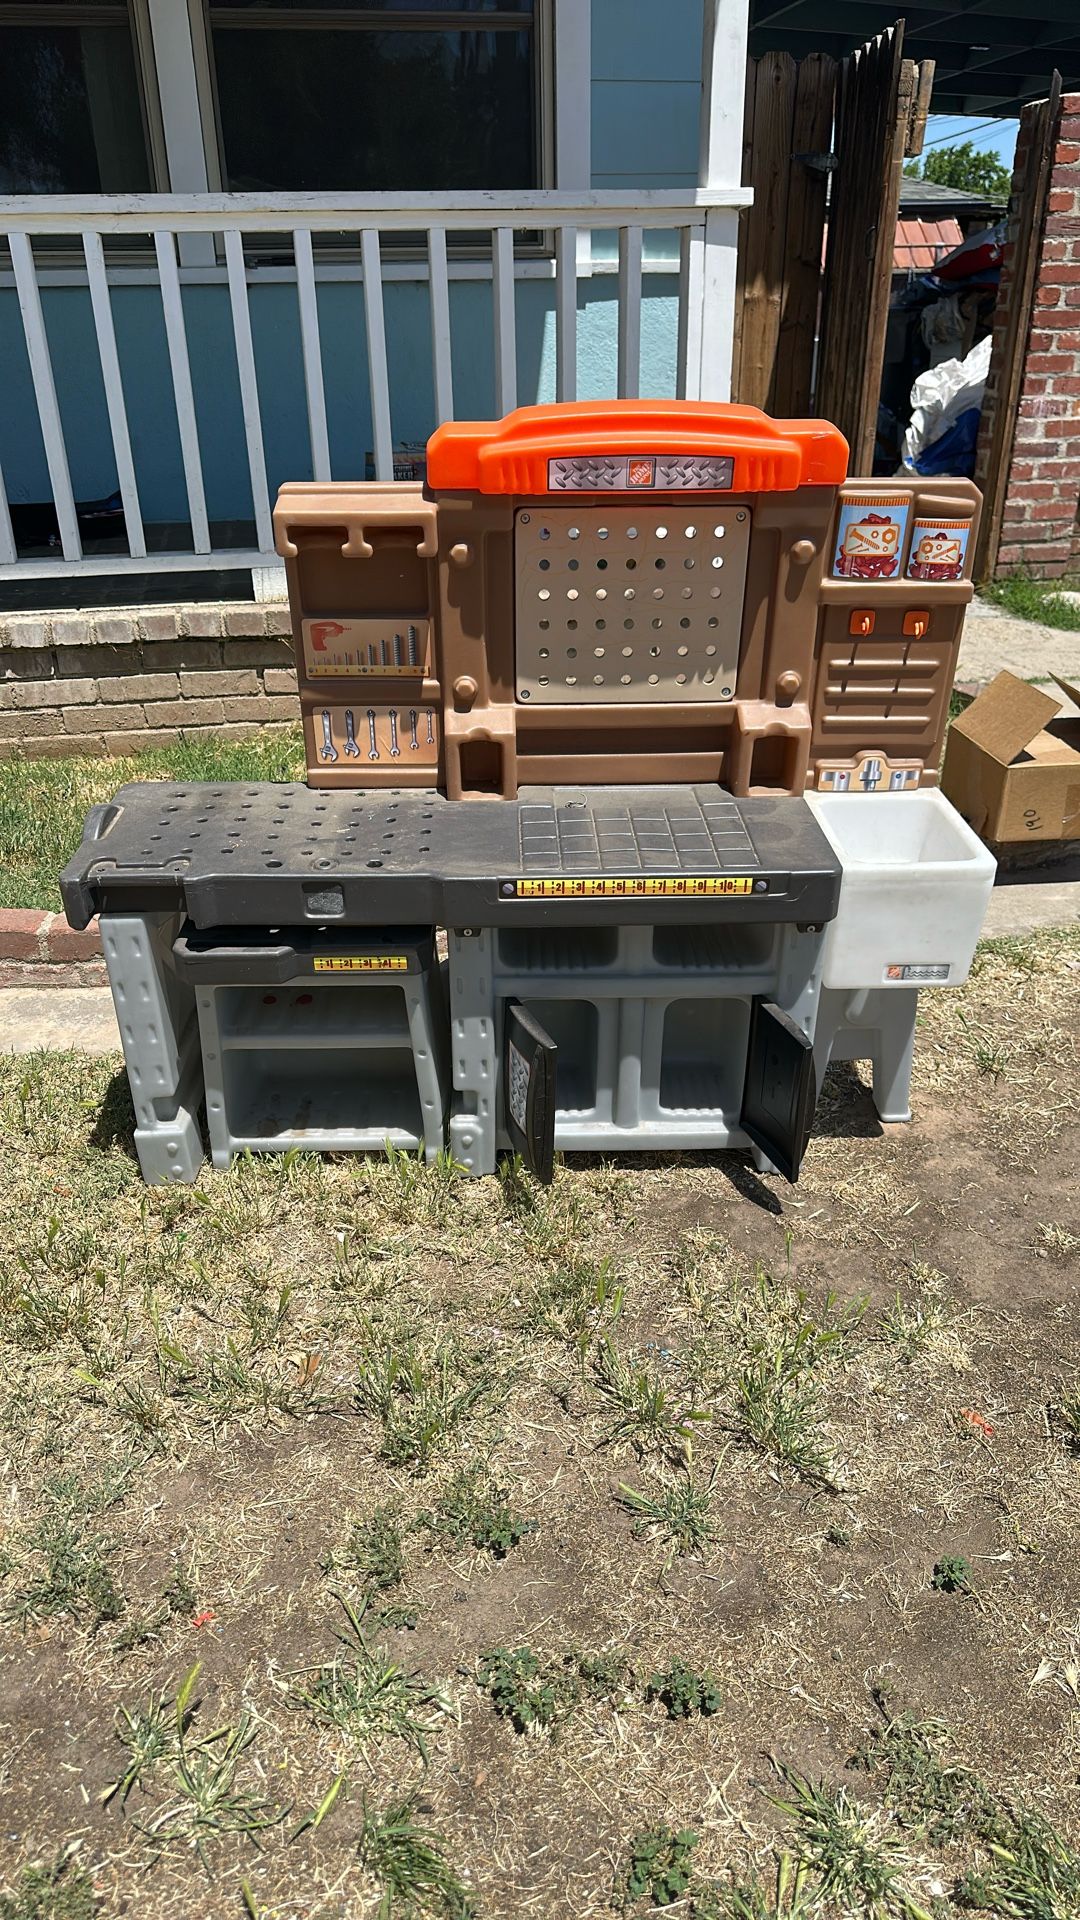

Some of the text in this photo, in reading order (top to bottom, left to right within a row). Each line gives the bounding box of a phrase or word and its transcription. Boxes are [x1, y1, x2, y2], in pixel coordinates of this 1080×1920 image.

[536, 882, 541, 892] 1
[556, 882, 562, 892] 2
[576, 882, 582, 892] 3
[596, 882, 602, 891] 4
[616, 882, 622, 891] 5
[637, 881, 642, 890] 6
[658, 881, 663, 890] 7
[677, 881, 683, 890] 8
[698, 881, 703, 890] 9
